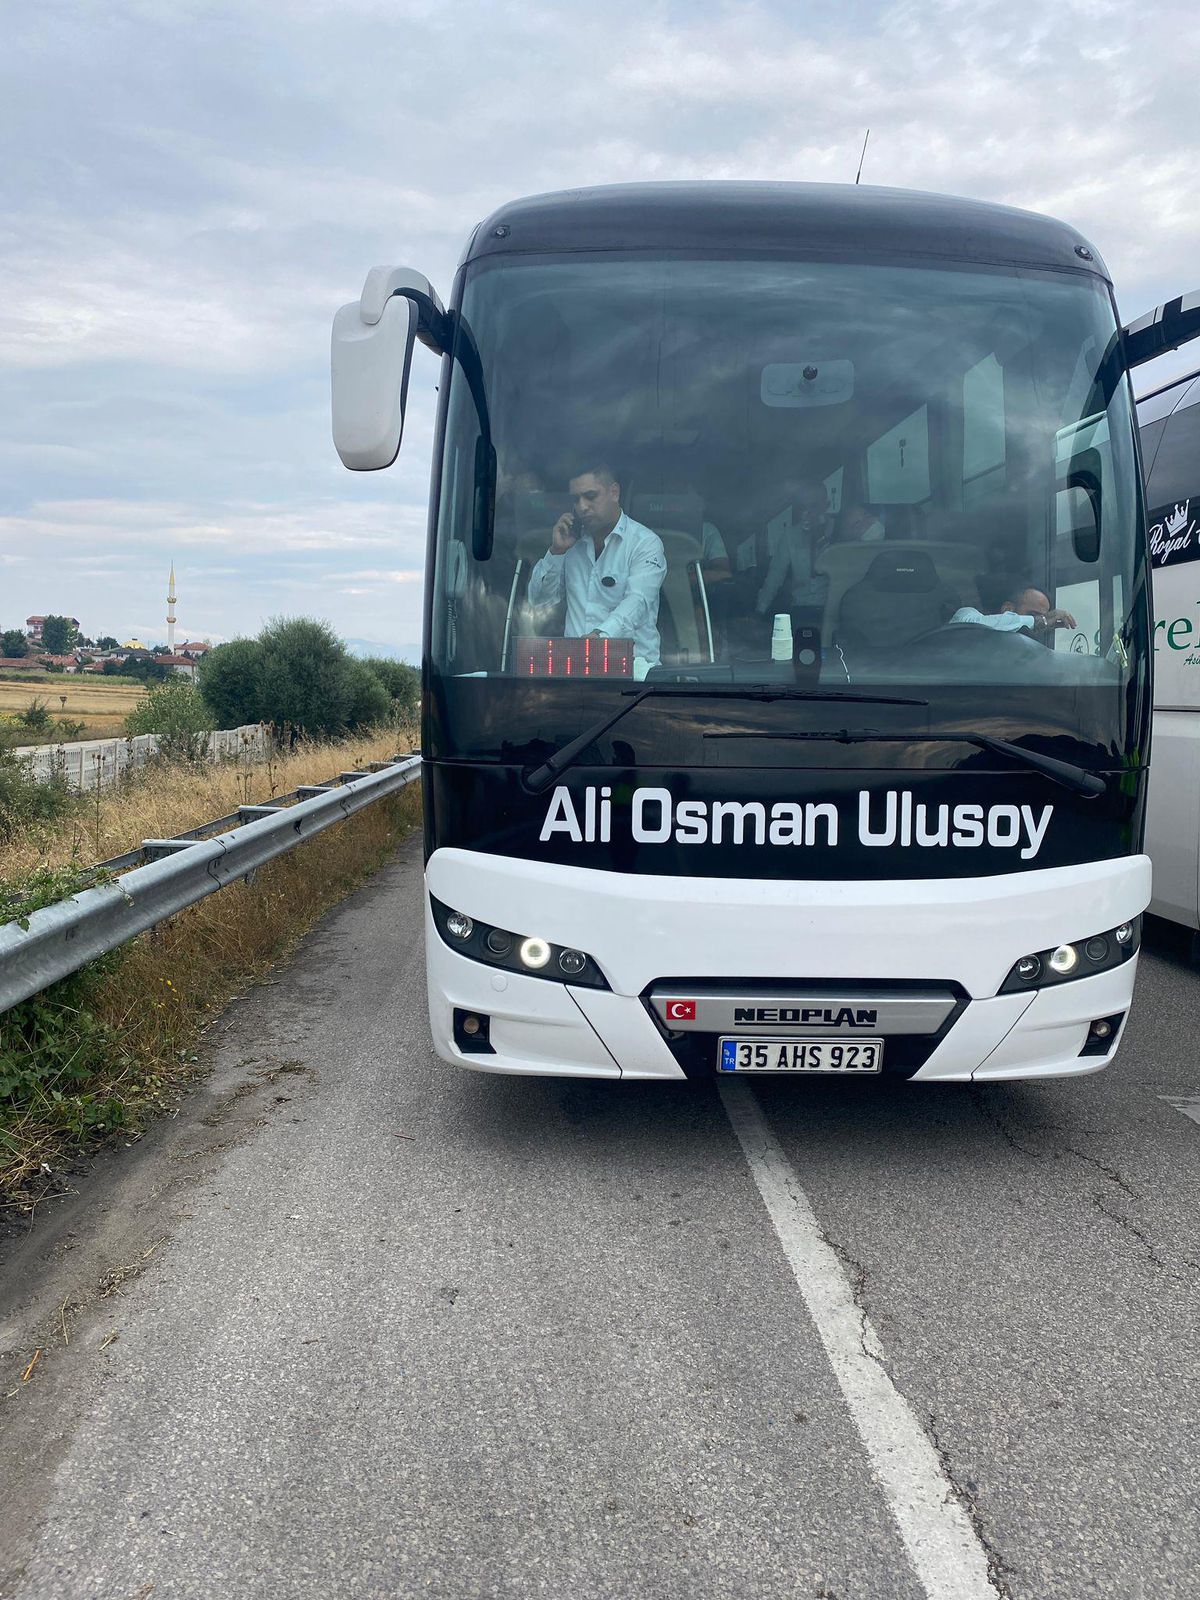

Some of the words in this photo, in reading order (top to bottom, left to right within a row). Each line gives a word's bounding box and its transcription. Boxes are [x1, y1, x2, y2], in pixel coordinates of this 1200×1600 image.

[1149, 519, 1196, 564] Royal
[539, 786, 611, 842] Ali
[632, 787, 838, 846] Osman
[858, 790, 1054, 859] Ulusoy
[734, 1007, 877, 1027] NEOPLAN
[724, 1057, 735, 1065] TR
[739, 1045, 768, 1068] 35
[777, 1045, 821, 1068] AHS
[830, 1046, 876, 1069] 923
